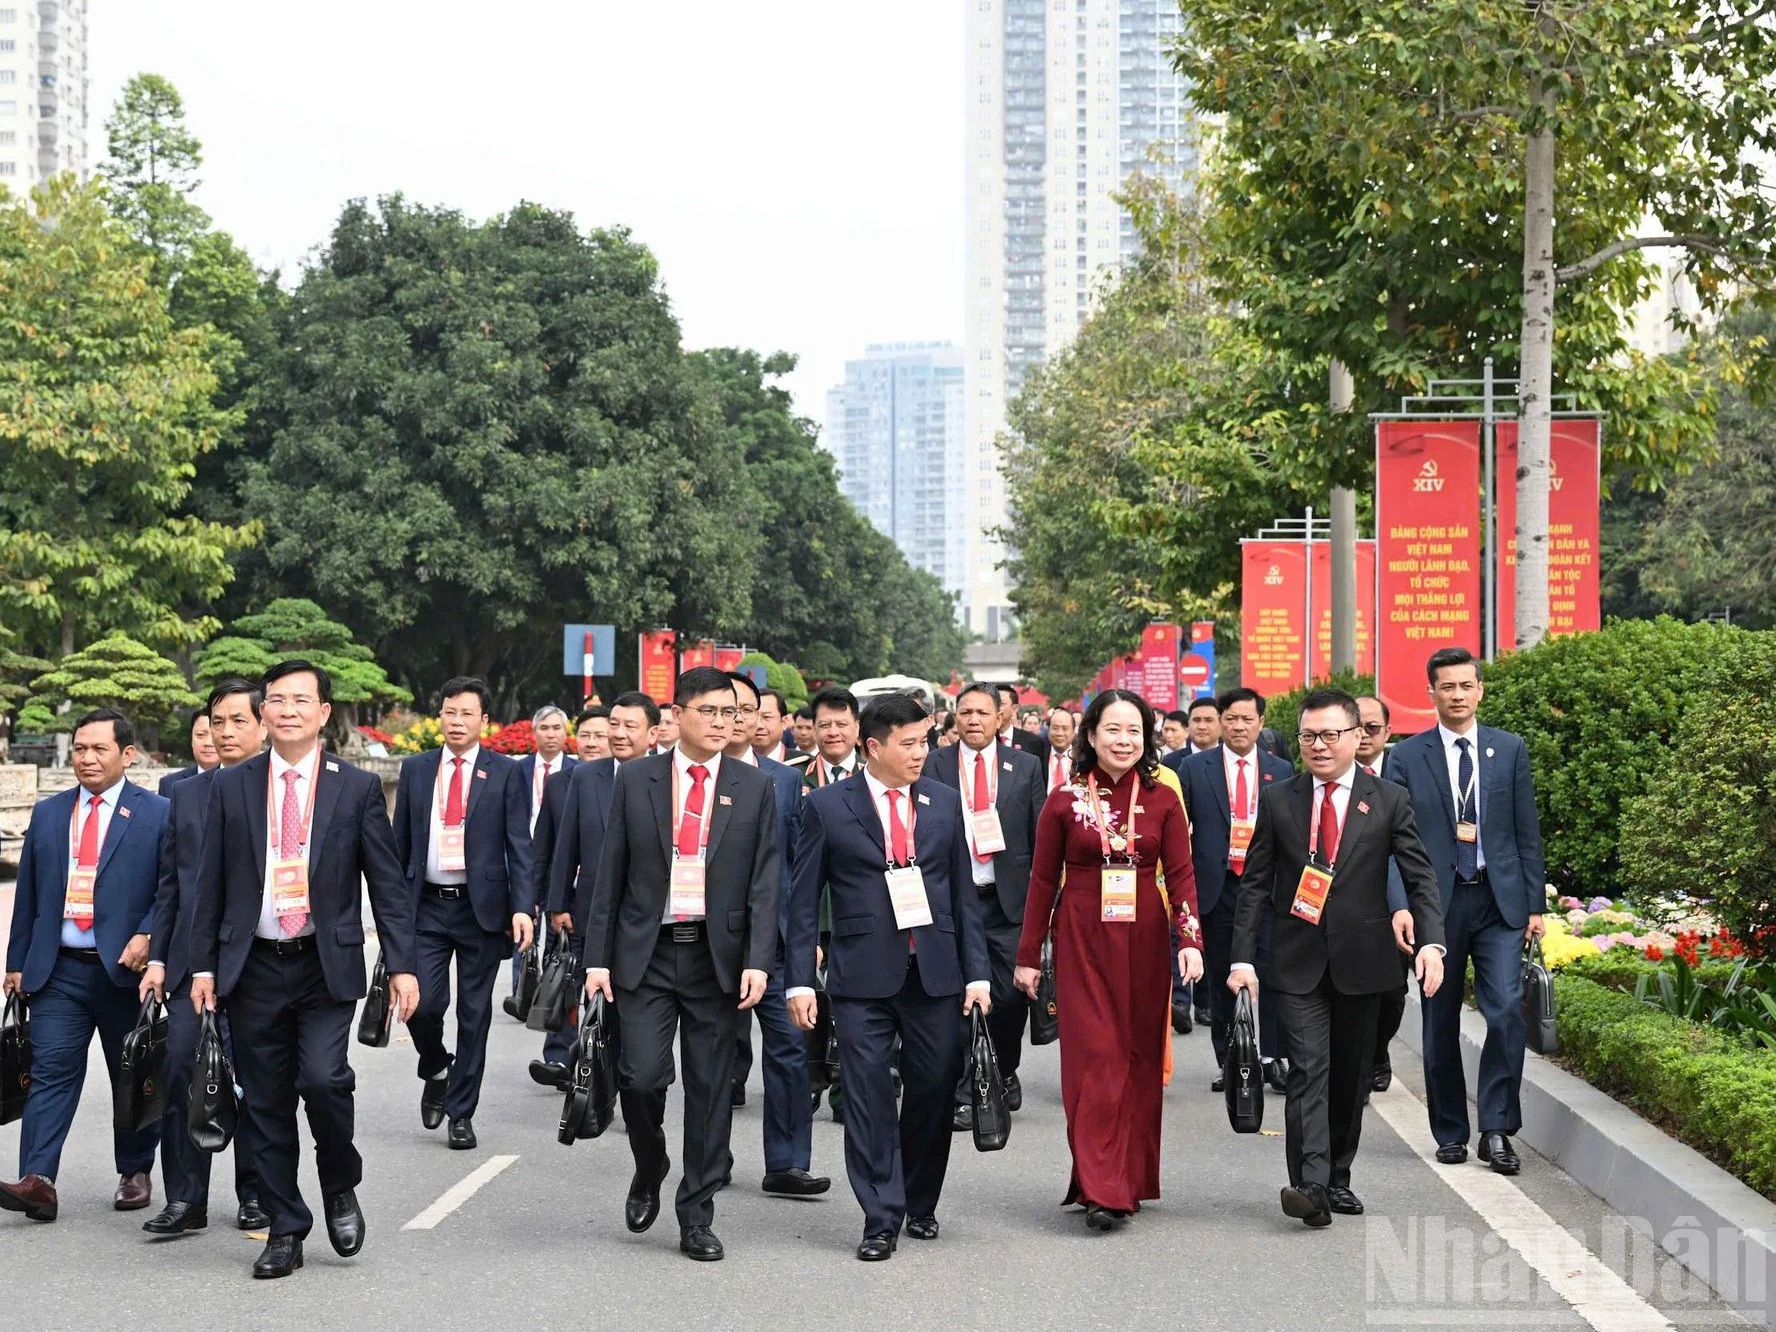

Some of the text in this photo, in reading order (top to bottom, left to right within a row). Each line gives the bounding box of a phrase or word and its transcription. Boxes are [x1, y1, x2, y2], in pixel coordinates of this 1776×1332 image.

[1412, 478, 1445, 492] XIV
[1390, 524, 1418, 539] ĐẢNG
[1420, 525, 1446, 540] CỘNG
[1407, 542, 1453, 557] VIỆT NAM
[1389, 558, 1419, 573] NGƯỜI
[1423, 574, 1451, 589] CHỨC
[1563, 567, 1582, 582] TỘC
[1390, 607, 1470, 624] CỦA CÁCH MẠNG
[1405, 625, 1425, 641] VIỆT
